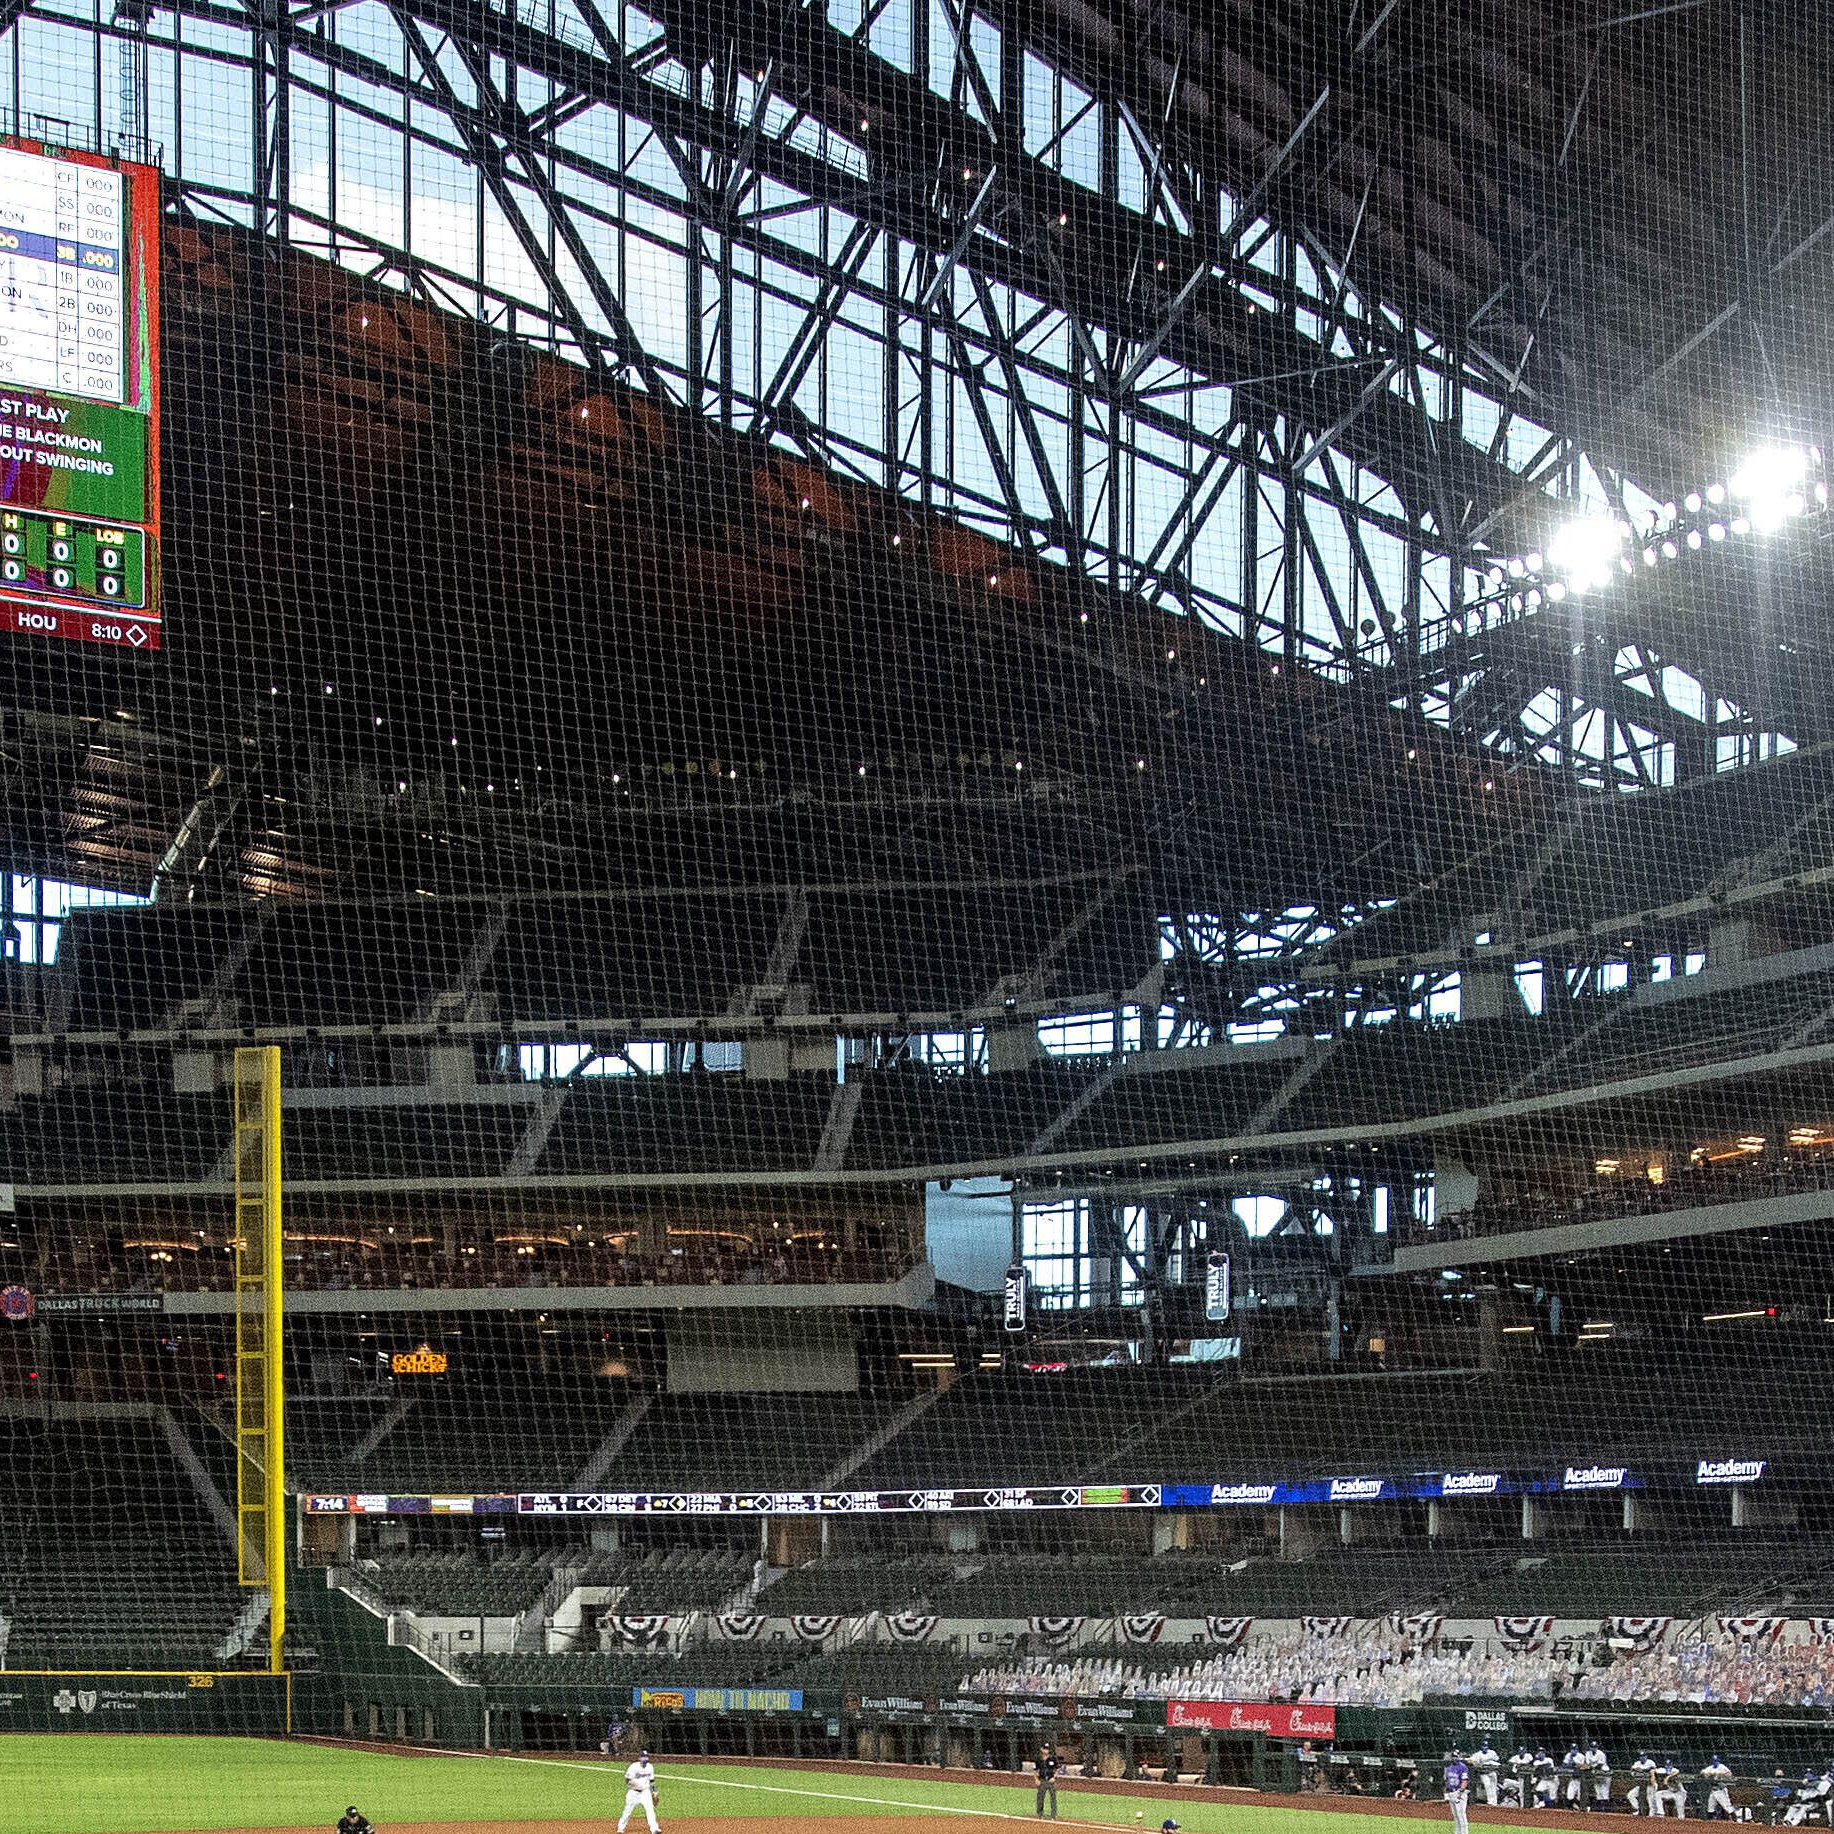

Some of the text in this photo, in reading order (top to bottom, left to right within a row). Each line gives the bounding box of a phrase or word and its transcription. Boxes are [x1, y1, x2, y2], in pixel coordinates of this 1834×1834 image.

[25, 403, 70, 423] PLAY
[14, 429, 102, 453] BLACKMON
[0, 445, 33, 464] OUT
[36, 450, 114, 476] SWINGING
[18, 612, 57, 630] HOU
[91, 623, 122, 640] 8:10
[1207, 1264, 1220, 1308] TRULY
[1006, 1277, 1017, 1321] TRULY
[392, 1354, 447, 1364] GOLDEN
[1566, 1466, 1626, 1487] Academy
[1698, 1459, 1764, 1481] Academy
[1212, 1484, 1274, 1502] Academy
[1331, 1479, 1382, 1497] Academy
[1443, 1473, 1498, 1493] Academy
[316, 1498, 344, 1510] 7:14
[188, 1676, 214, 1688] 326
[1477, 1711, 1506, 1722] DALLAS
